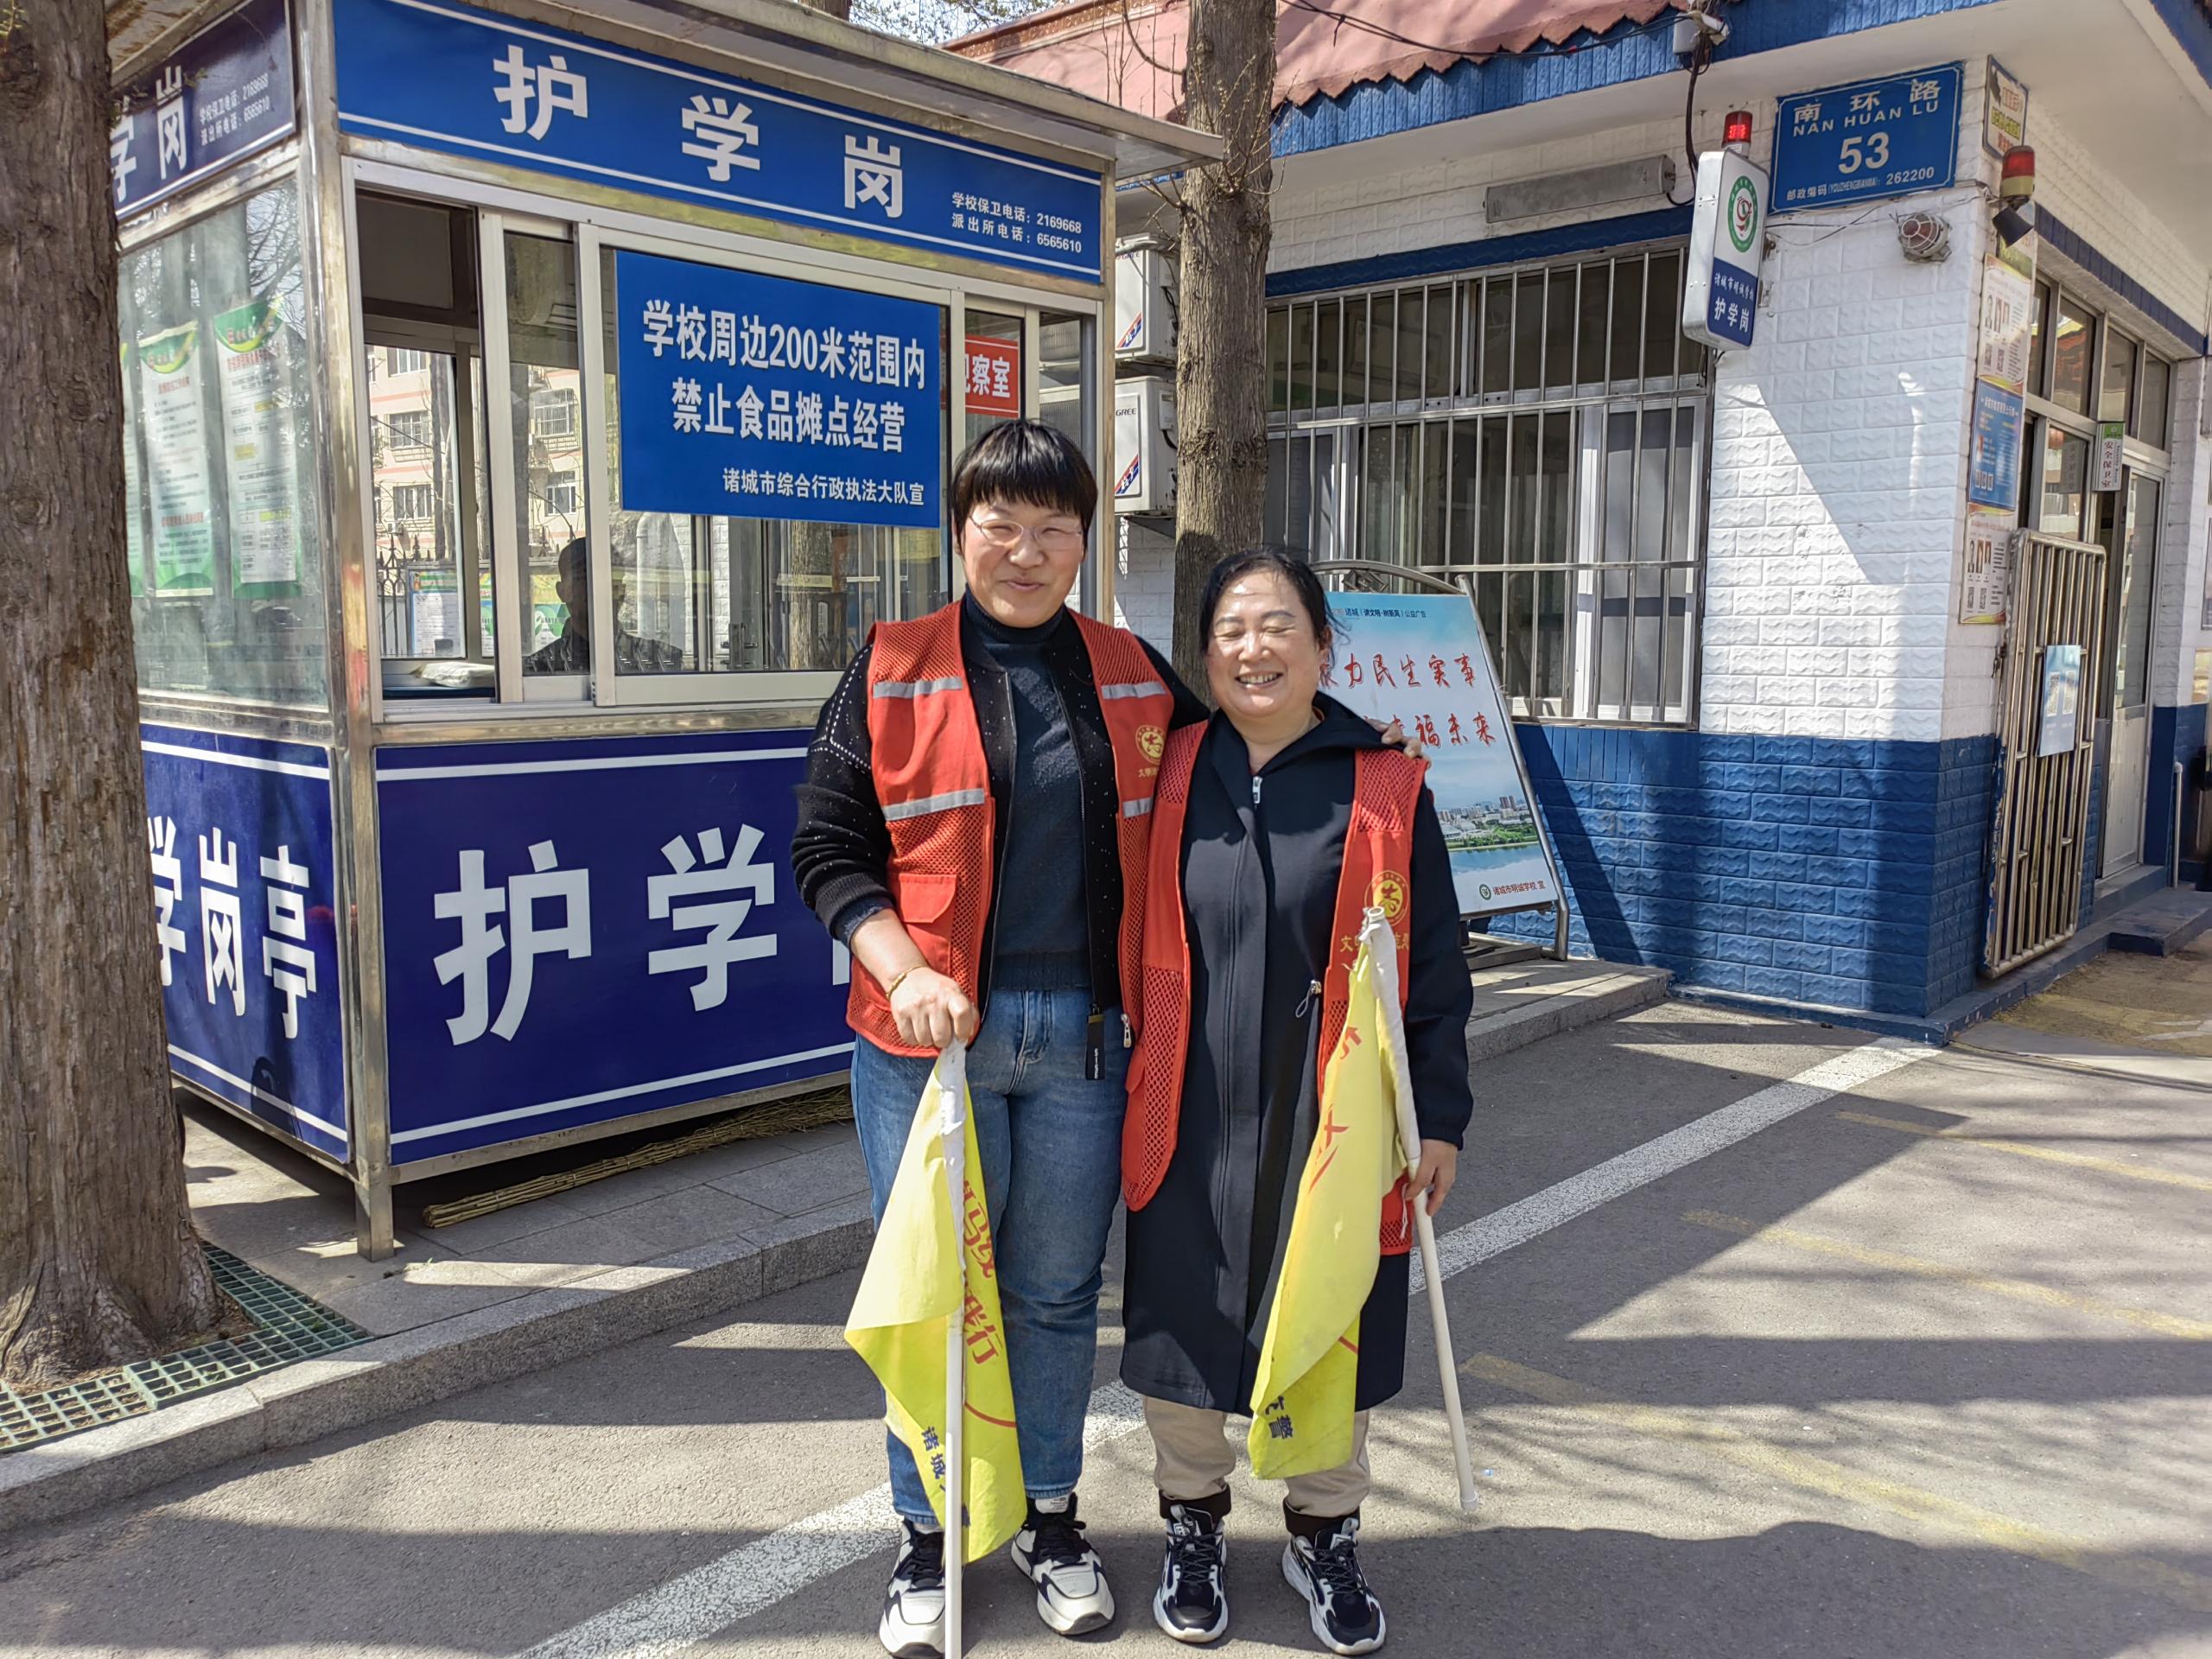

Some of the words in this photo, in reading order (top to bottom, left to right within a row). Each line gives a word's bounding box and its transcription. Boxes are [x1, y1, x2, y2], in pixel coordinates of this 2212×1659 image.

[1793, 79, 1942, 124] 南环路
[1793, 119, 1834, 137] NAN
[1844, 106, 1902, 128] HUAN
[1912, 100, 1939, 115] LU
[493, 44, 904, 218] 护学岗
[1839, 131, 1890, 174] 53
[1885, 167, 1935, 186] 262200
[1713, 296, 1750, 334] 护学岗
[643, 299, 925, 390] 学校周边200米范围内
[671, 378, 906, 453] 禁止食品摊点经营
[1116, 408, 1137, 416] GREE
[722, 467, 925, 506] 诸城市综合行政执法大队宣
[434, 823, 851, 1046] 护学
